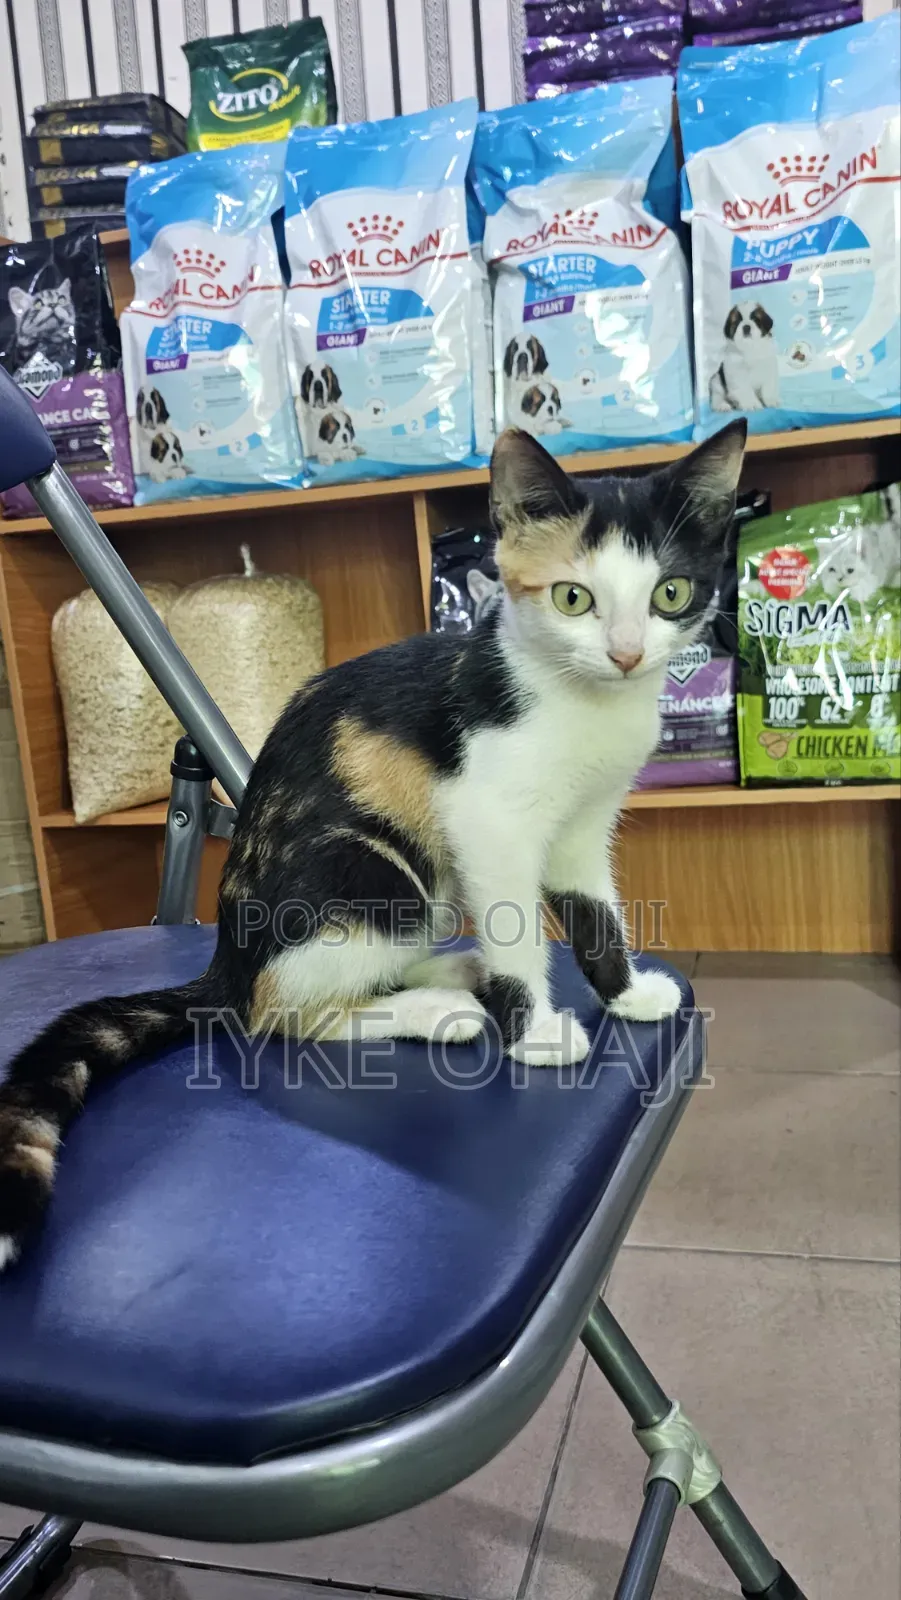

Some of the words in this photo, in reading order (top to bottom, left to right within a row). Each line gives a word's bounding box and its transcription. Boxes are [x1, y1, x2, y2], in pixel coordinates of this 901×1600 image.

[217, 84, 279, 113] ZITO
[722, 191, 796, 223] ROYAL
[804, 146, 878, 208] CANIN
[376, 229, 440, 266] CANIN
[506, 222, 572, 252] ROYAL
[746, 227, 820, 259] PUPPY
[528, 255, 597, 277] STARTER
[742, 269, 780, 285] GIANT
[533, 299, 566, 318] GIANT
[855, 354, 865, 369] 3
[411, 420, 418, 431] 2
[235, 441, 242, 451] 2
[796, 735, 868, 758] CHICKEN
